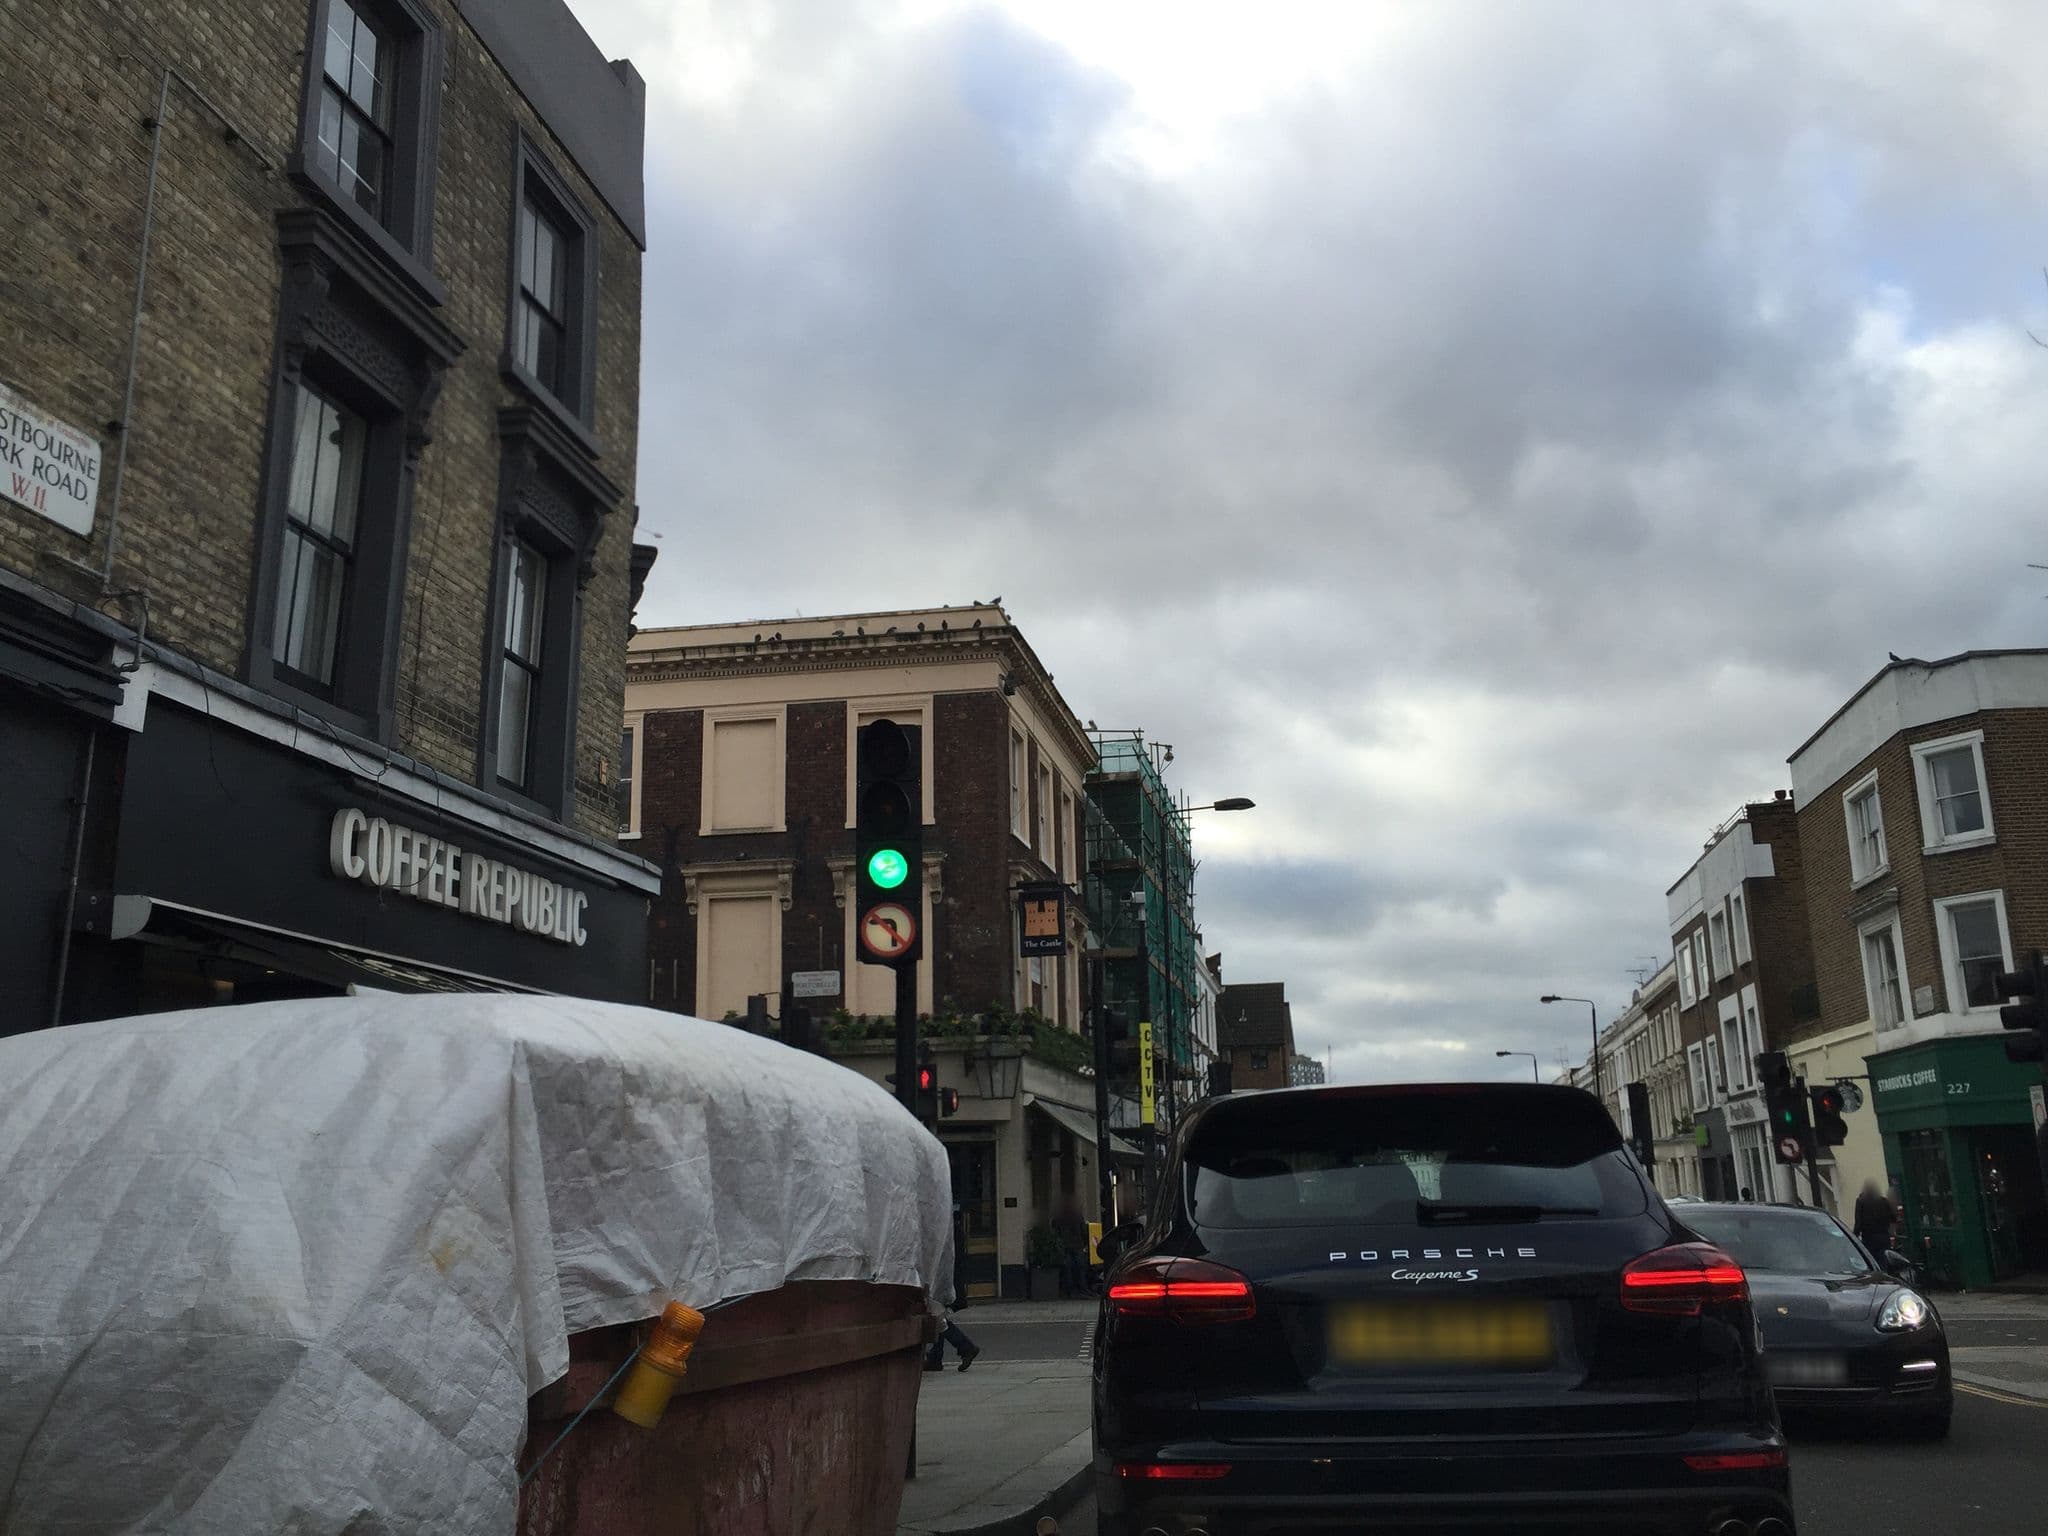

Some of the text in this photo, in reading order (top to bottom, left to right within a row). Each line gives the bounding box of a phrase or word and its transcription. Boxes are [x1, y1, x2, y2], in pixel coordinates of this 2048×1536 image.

[331, 808, 588, 946] COFFEE REPUBLIC
[1024, 939, 1062, 948] The Castle
[1144, 1030, 1152, 1098] CCTV
[1877, 1069, 1937, 1092] STARBUCKS COFFEE
[1947, 1083, 1970, 1094] 227
[1329, 1248, 1537, 1261] PORSCHE
[1391, 1269, 1479, 1284] Cayenne S
